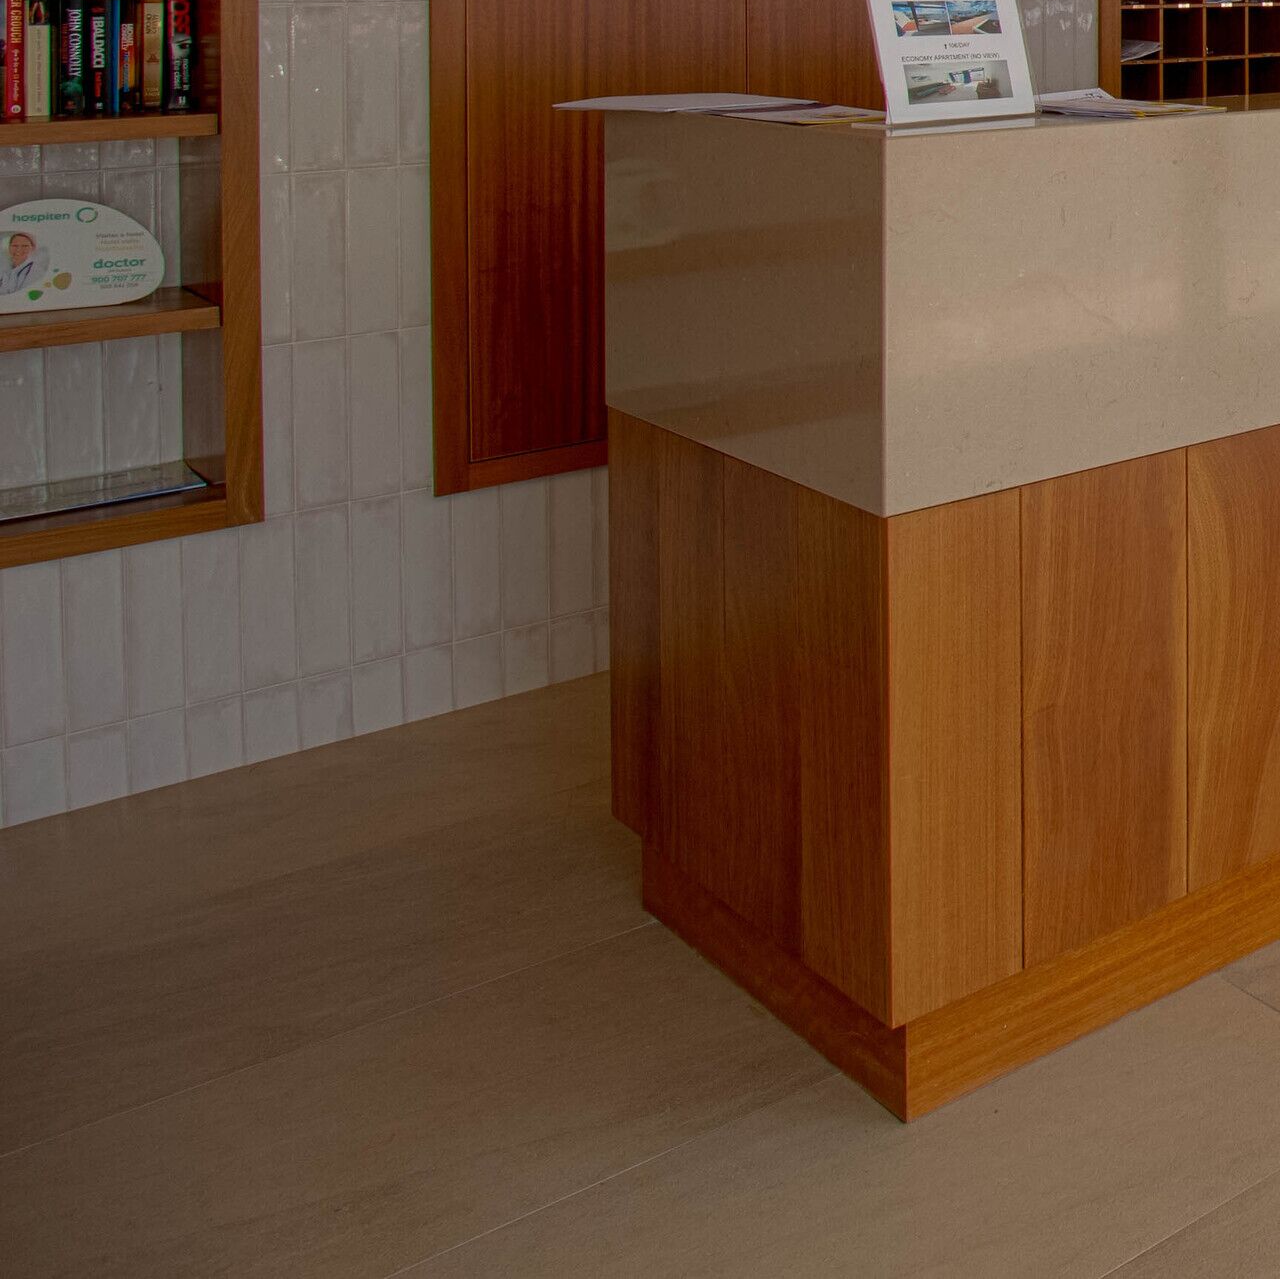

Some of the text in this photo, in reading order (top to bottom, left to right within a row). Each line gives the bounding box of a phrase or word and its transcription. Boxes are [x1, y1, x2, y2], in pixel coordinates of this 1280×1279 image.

[10, 9, 22, 44] CROUCH
[67, 8, 82, 77] JOHN CONNOLLY
[93, 20, 106, 68] BALDACCI
[12, 212, 71, 223] hospiten
[93, 258, 147, 269] doctor
